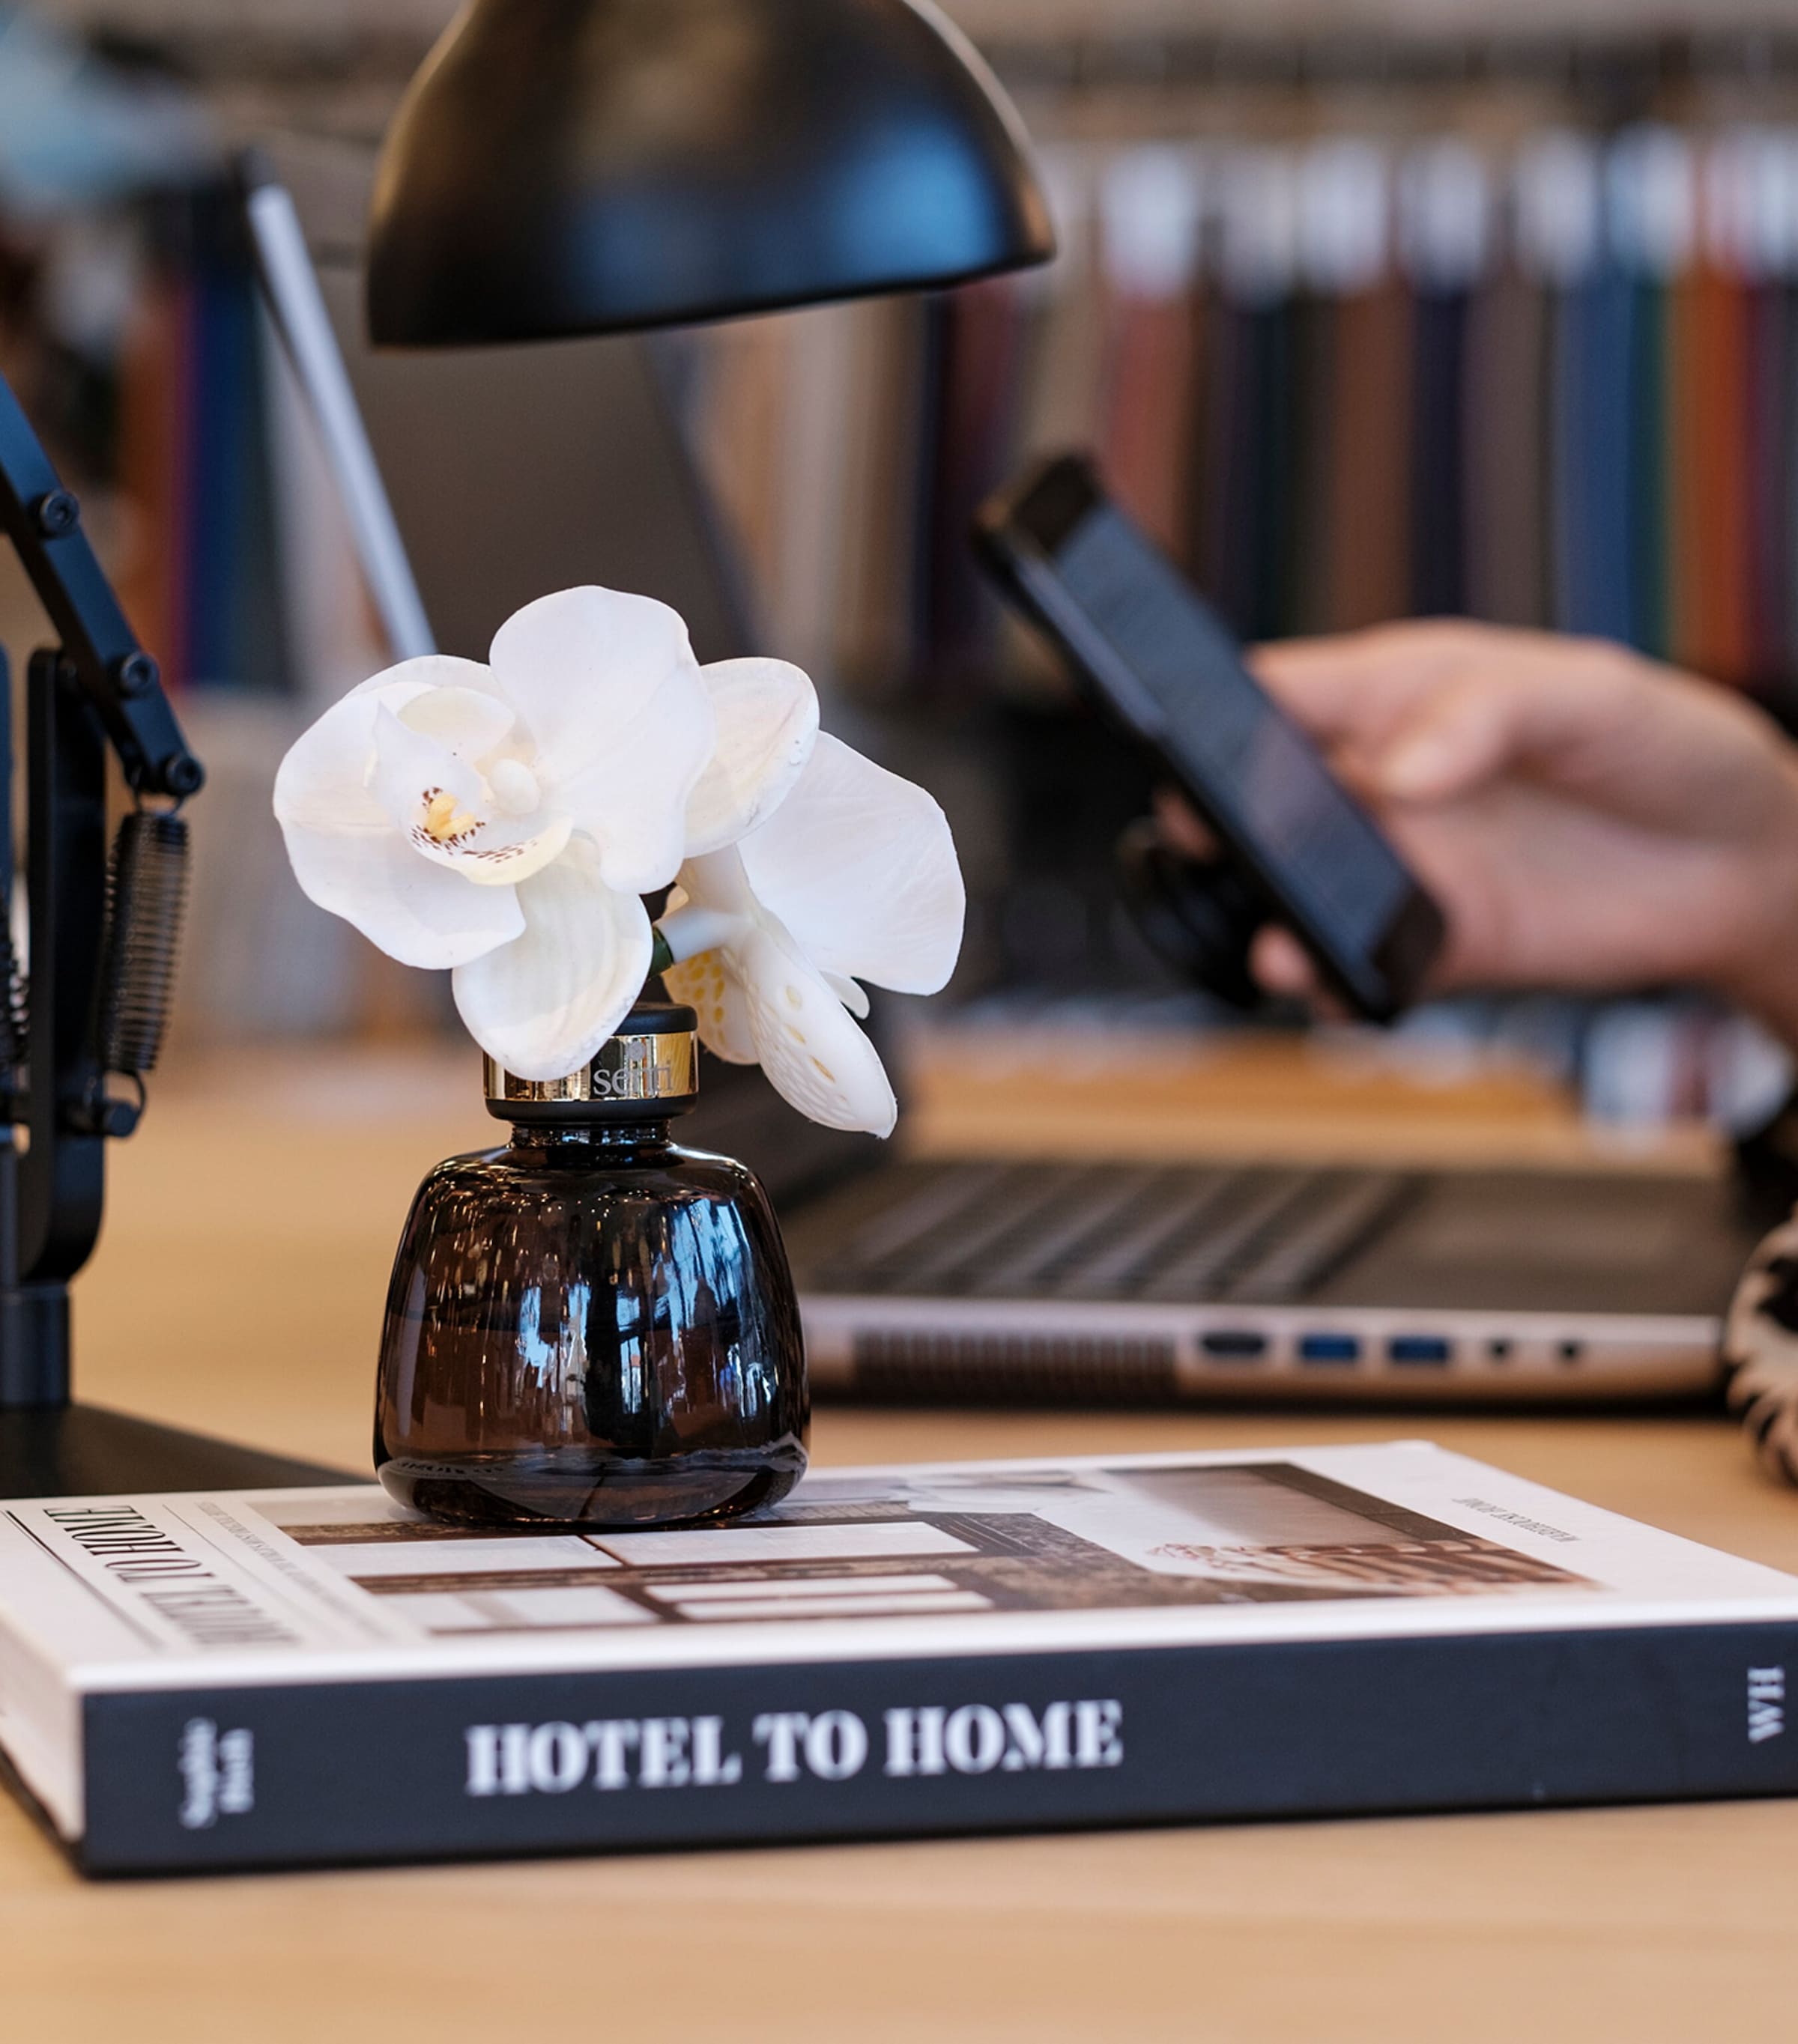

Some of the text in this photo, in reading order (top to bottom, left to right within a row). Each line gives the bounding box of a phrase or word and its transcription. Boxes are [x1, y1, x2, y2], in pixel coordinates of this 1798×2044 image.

[43, 1505, 185, 1556] HOME
[104, 1558, 215, 1583] TO
[1747, 1665, 1785, 1744] WH
[464, 1699, 1123, 1795] HOTEL TO HOME
